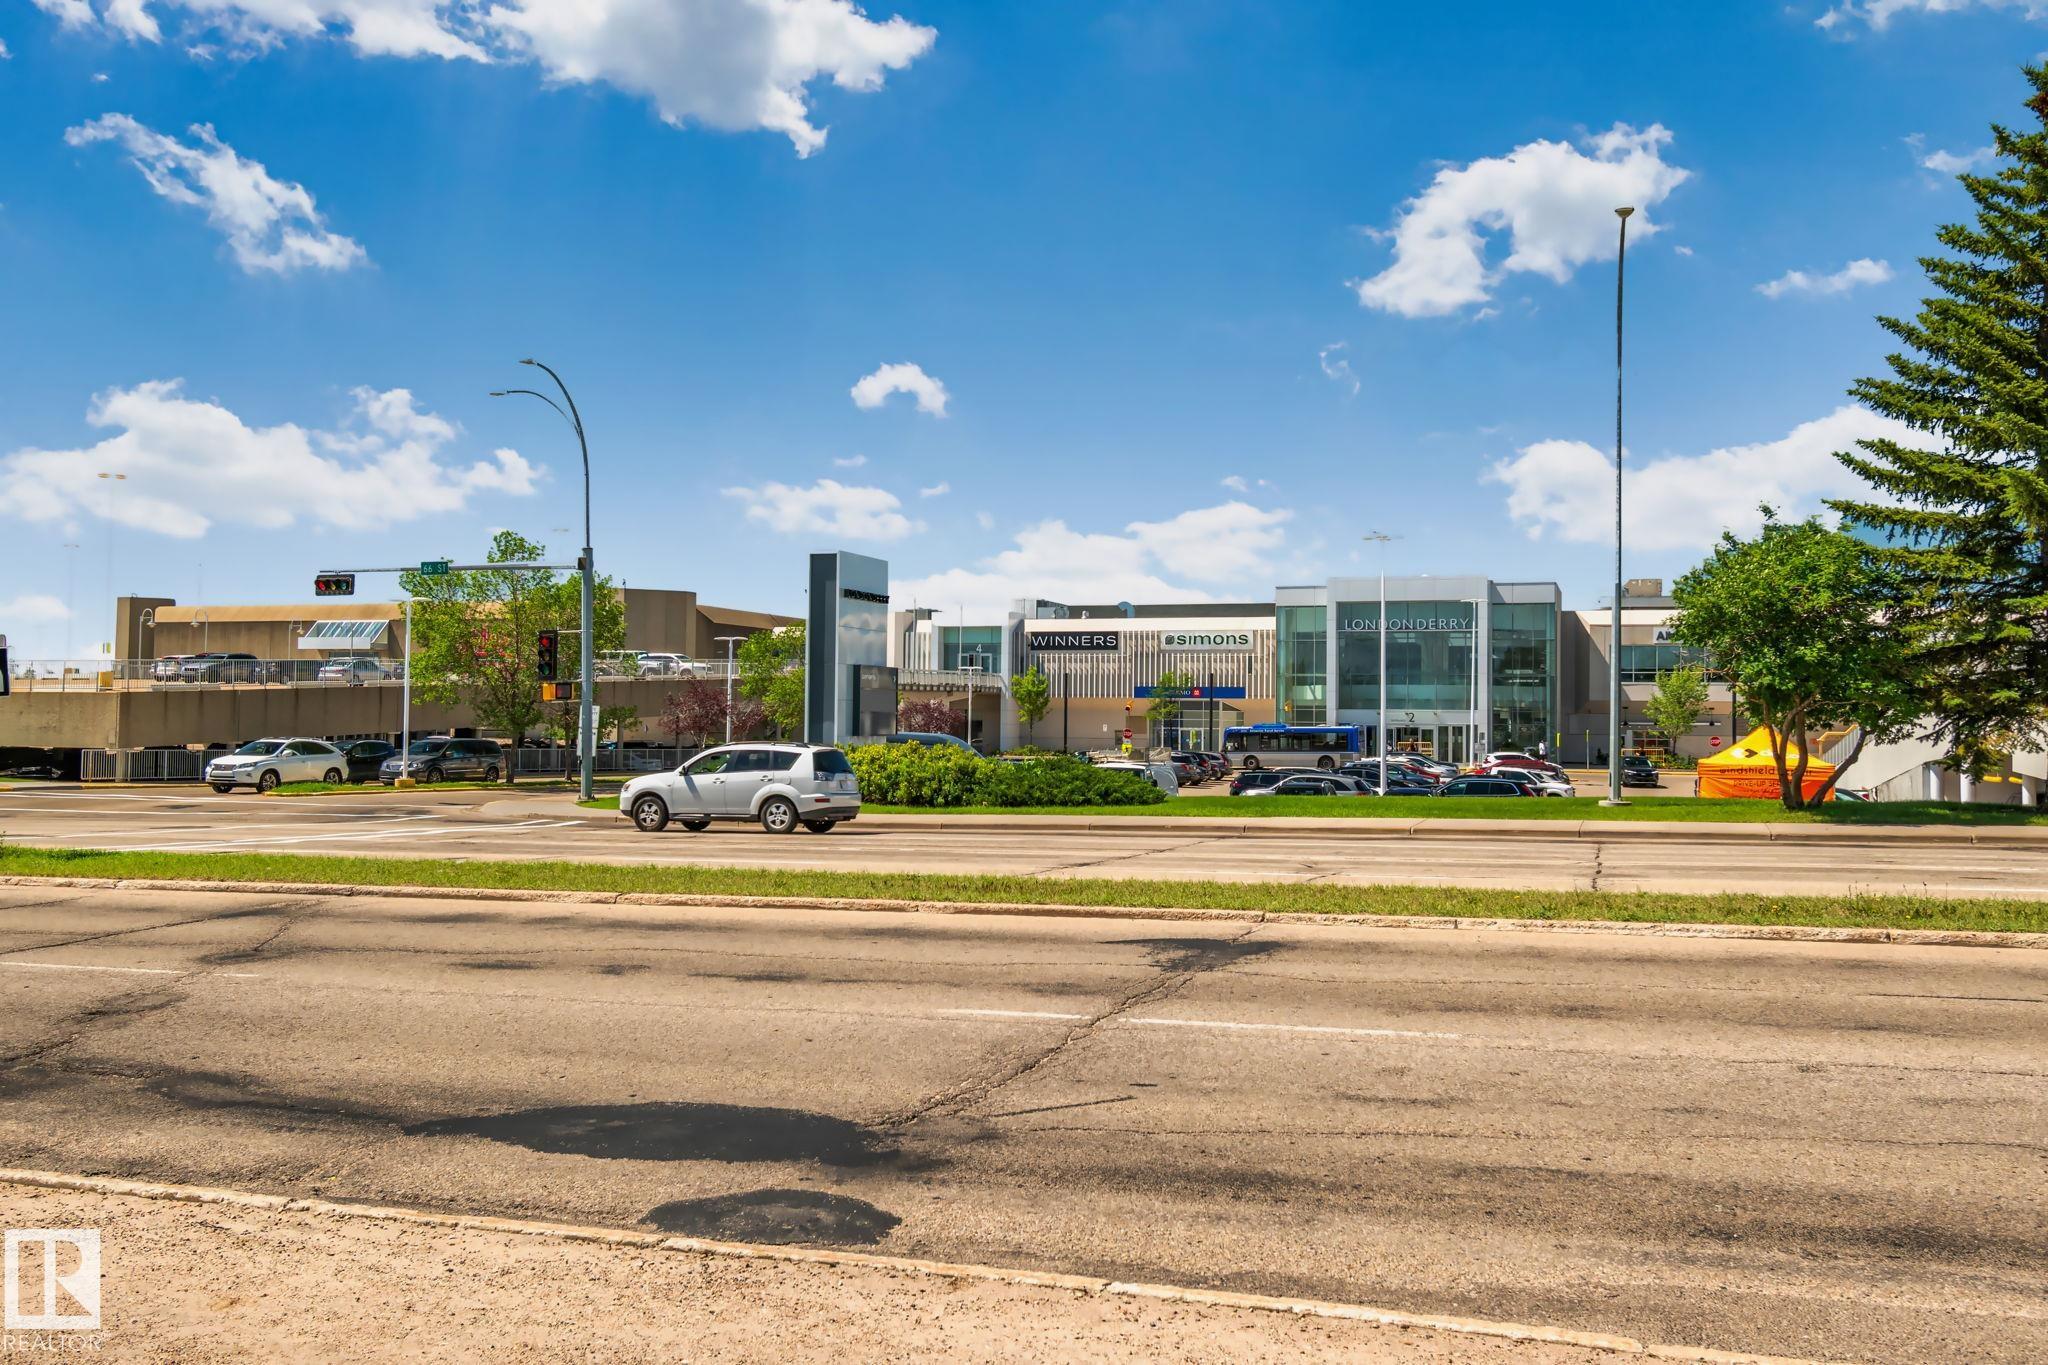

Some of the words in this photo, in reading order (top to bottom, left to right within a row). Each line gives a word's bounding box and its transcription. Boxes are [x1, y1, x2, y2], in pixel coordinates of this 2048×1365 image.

[423, 564, 433, 573] 66
[437, 564, 446, 573] ST
[1344, 618, 1470, 631] LONDONDERRY
[1031, 635, 1117, 646] WINNERS
[1176, 634, 1249, 645] simons
[976, 643, 983, 654] 4
[1408, 712, 1415, 723] 2
[1719, 765, 1775, 775] windshield
